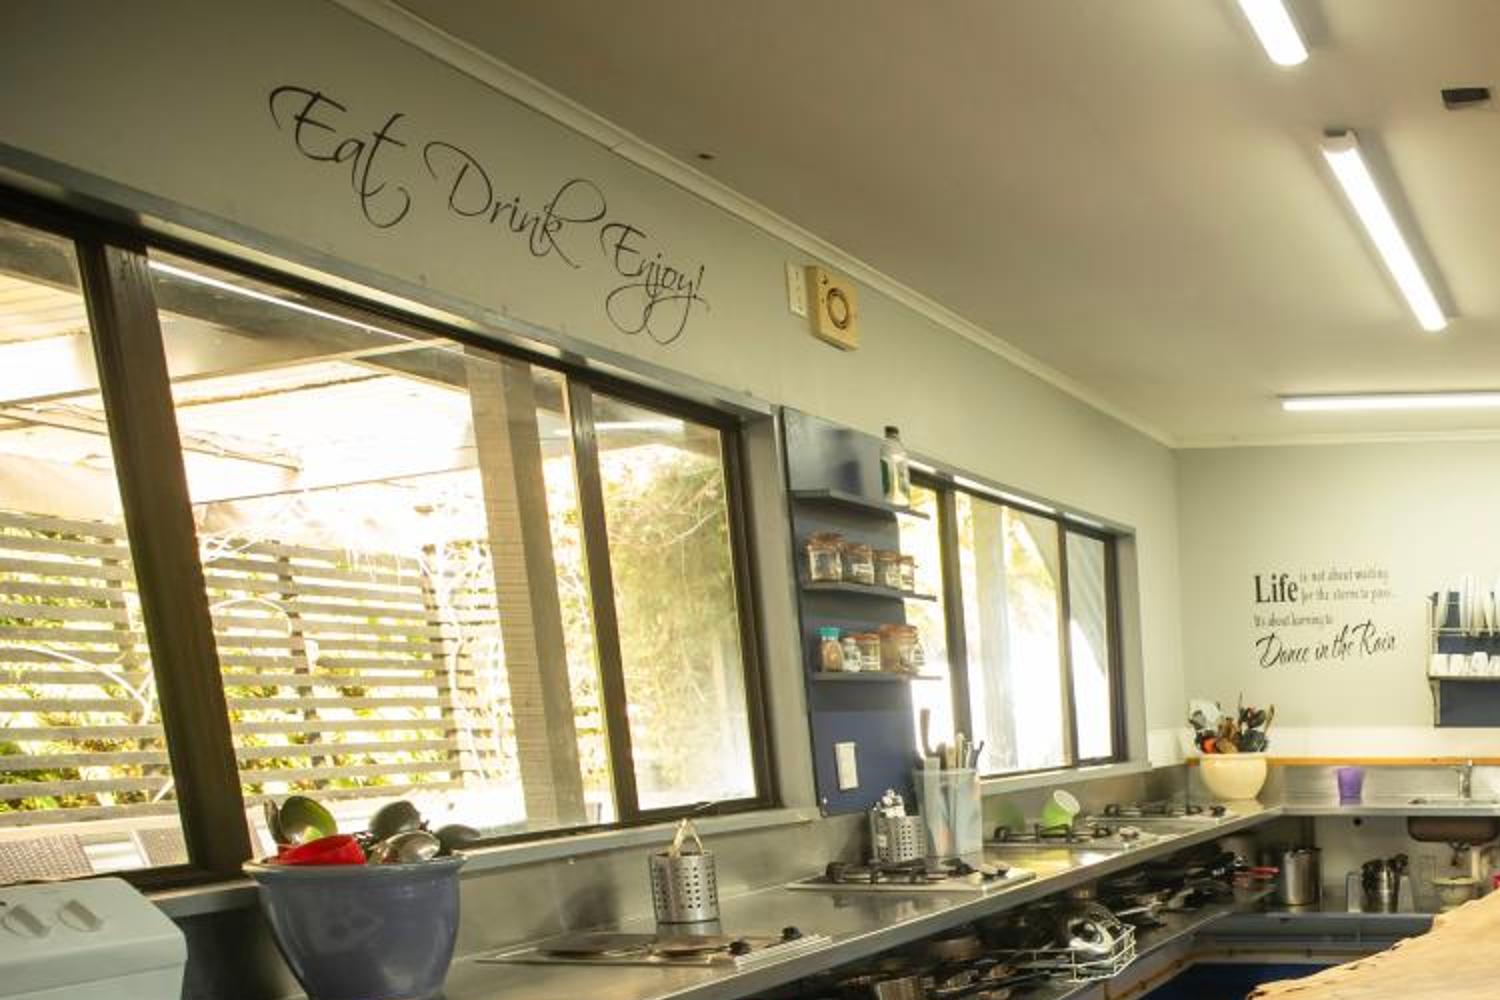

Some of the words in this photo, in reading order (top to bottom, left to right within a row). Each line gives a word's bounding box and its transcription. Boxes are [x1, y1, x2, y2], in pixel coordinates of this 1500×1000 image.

[268, 86, 410, 228] Eat
[423, 141, 607, 269] Drink
[601, 223, 710, 345] Enjoy!
[1254, 573, 1299, 603] Life
[1255, 632, 1310, 669] Dance
[1331, 624, 1354, 662] the
[1351, 617, 1396, 657] Rain
